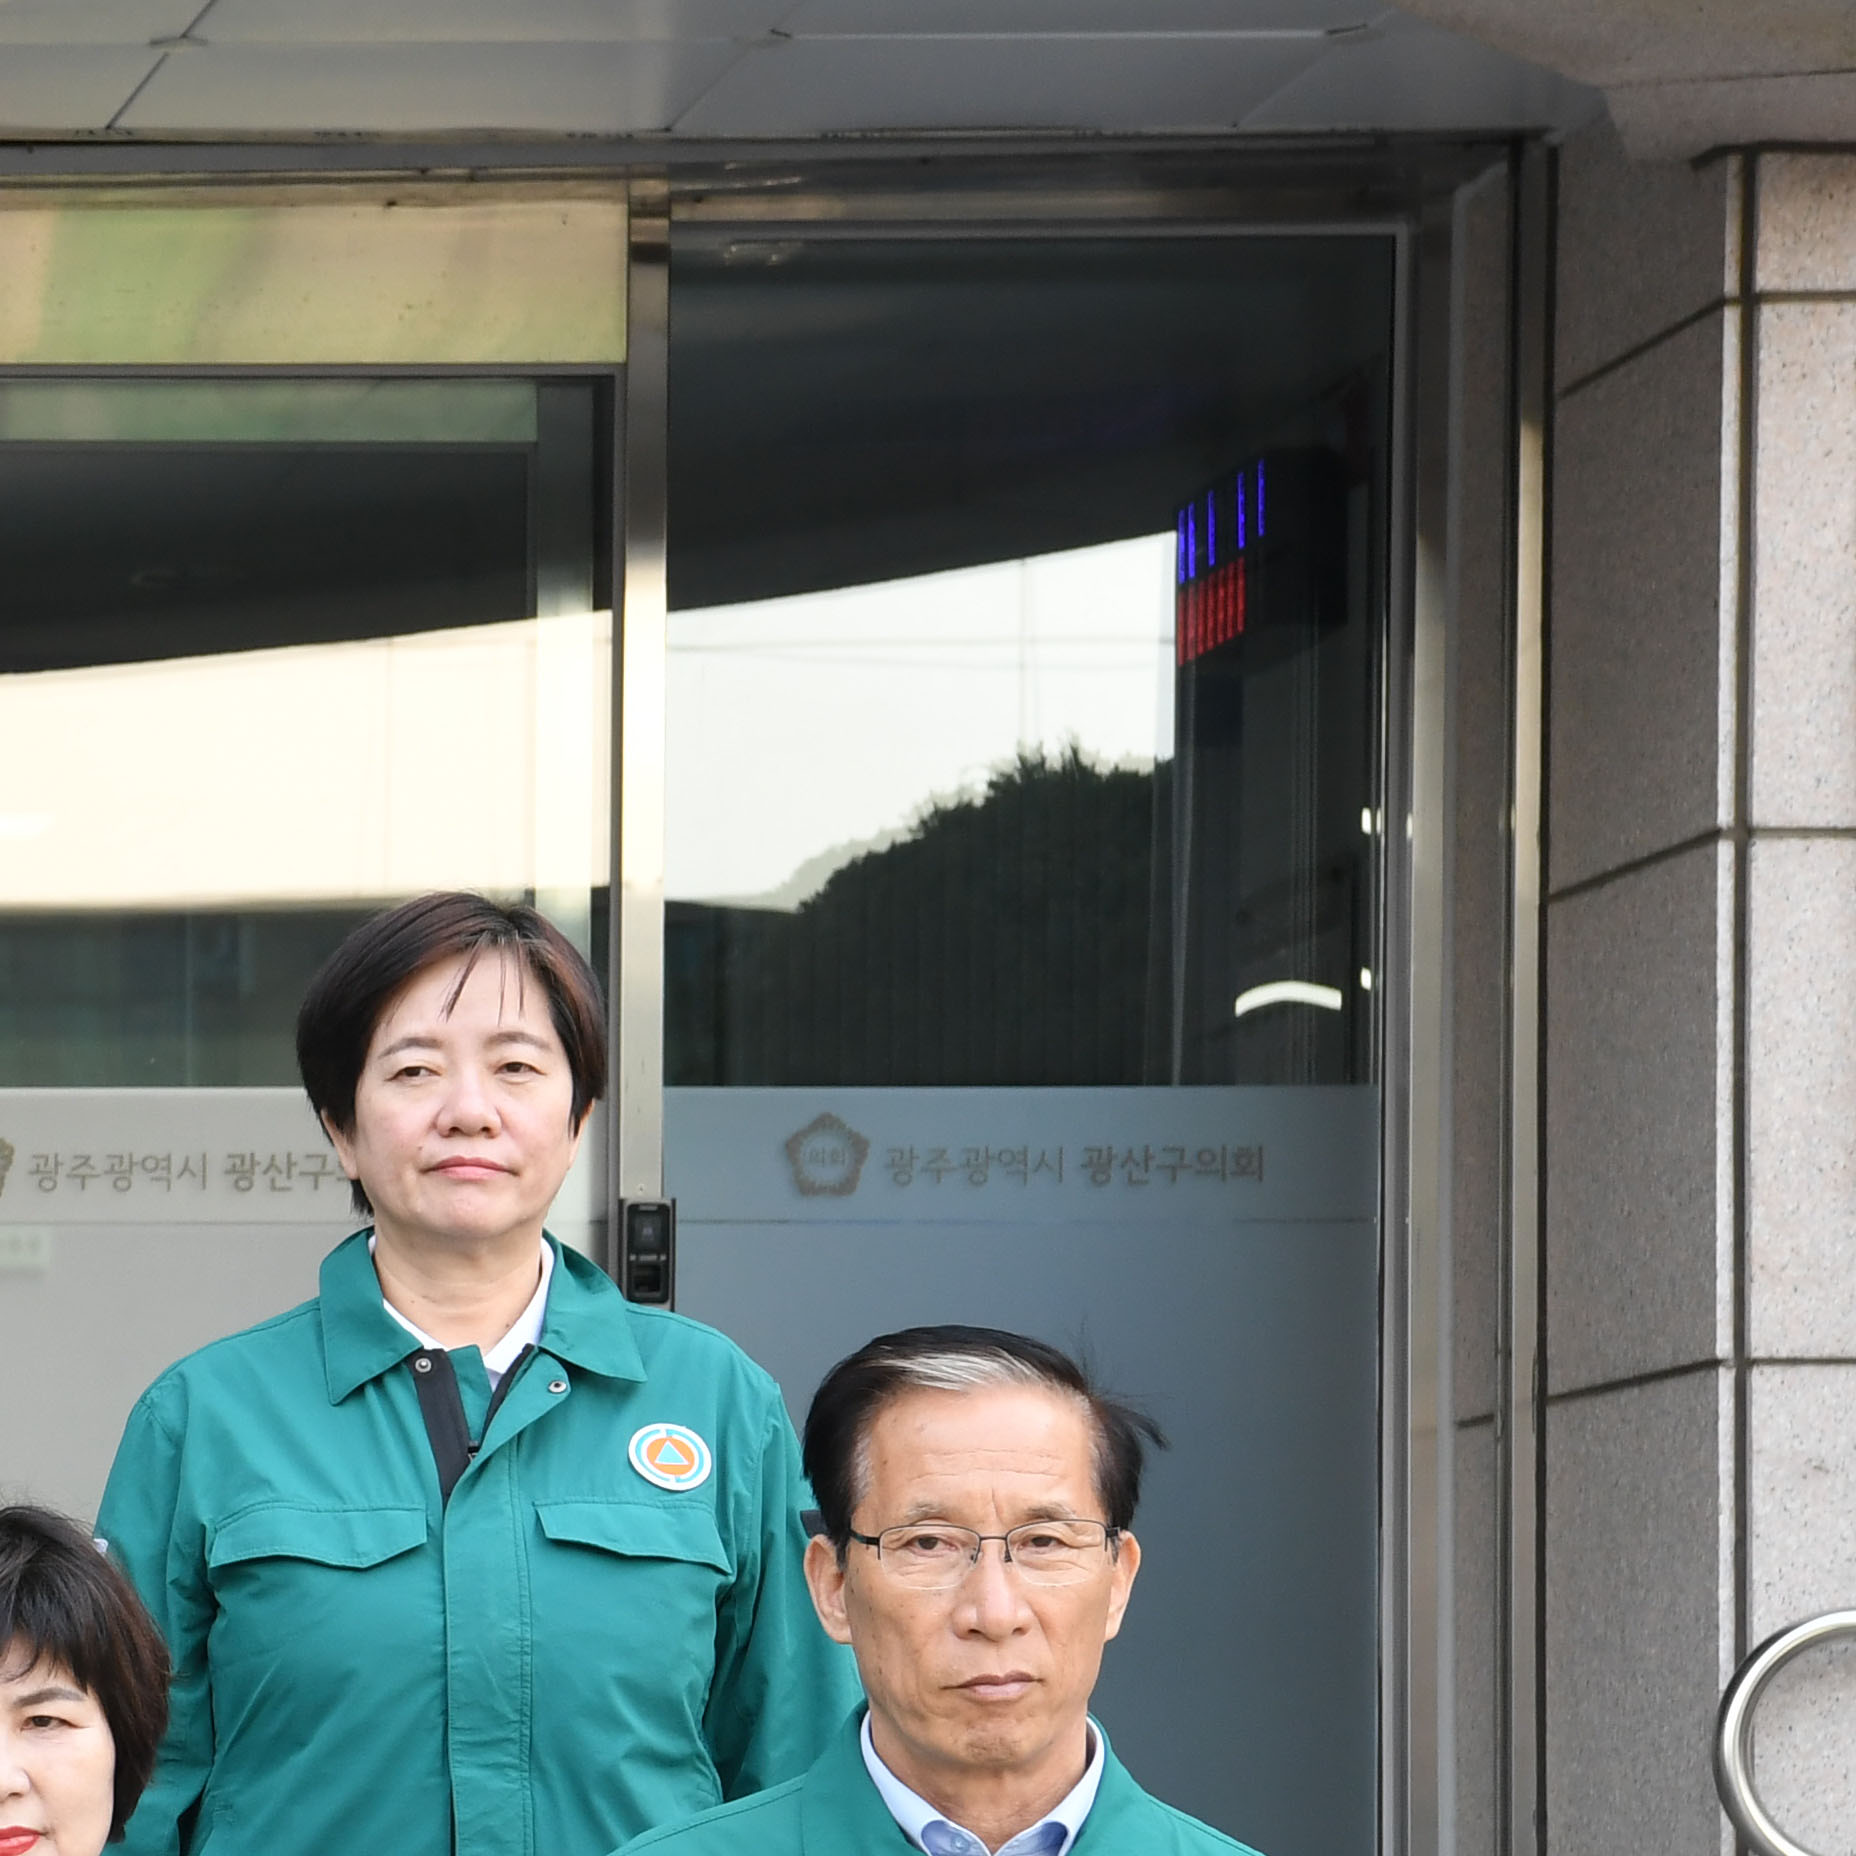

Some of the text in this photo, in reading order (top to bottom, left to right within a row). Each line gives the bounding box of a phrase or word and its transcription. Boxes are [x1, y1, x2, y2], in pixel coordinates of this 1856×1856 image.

[28, 1152, 347, 1193] 광주광역시 광산구
[885, 1144, 1264, 1188] 광주광역시 광산구의회
